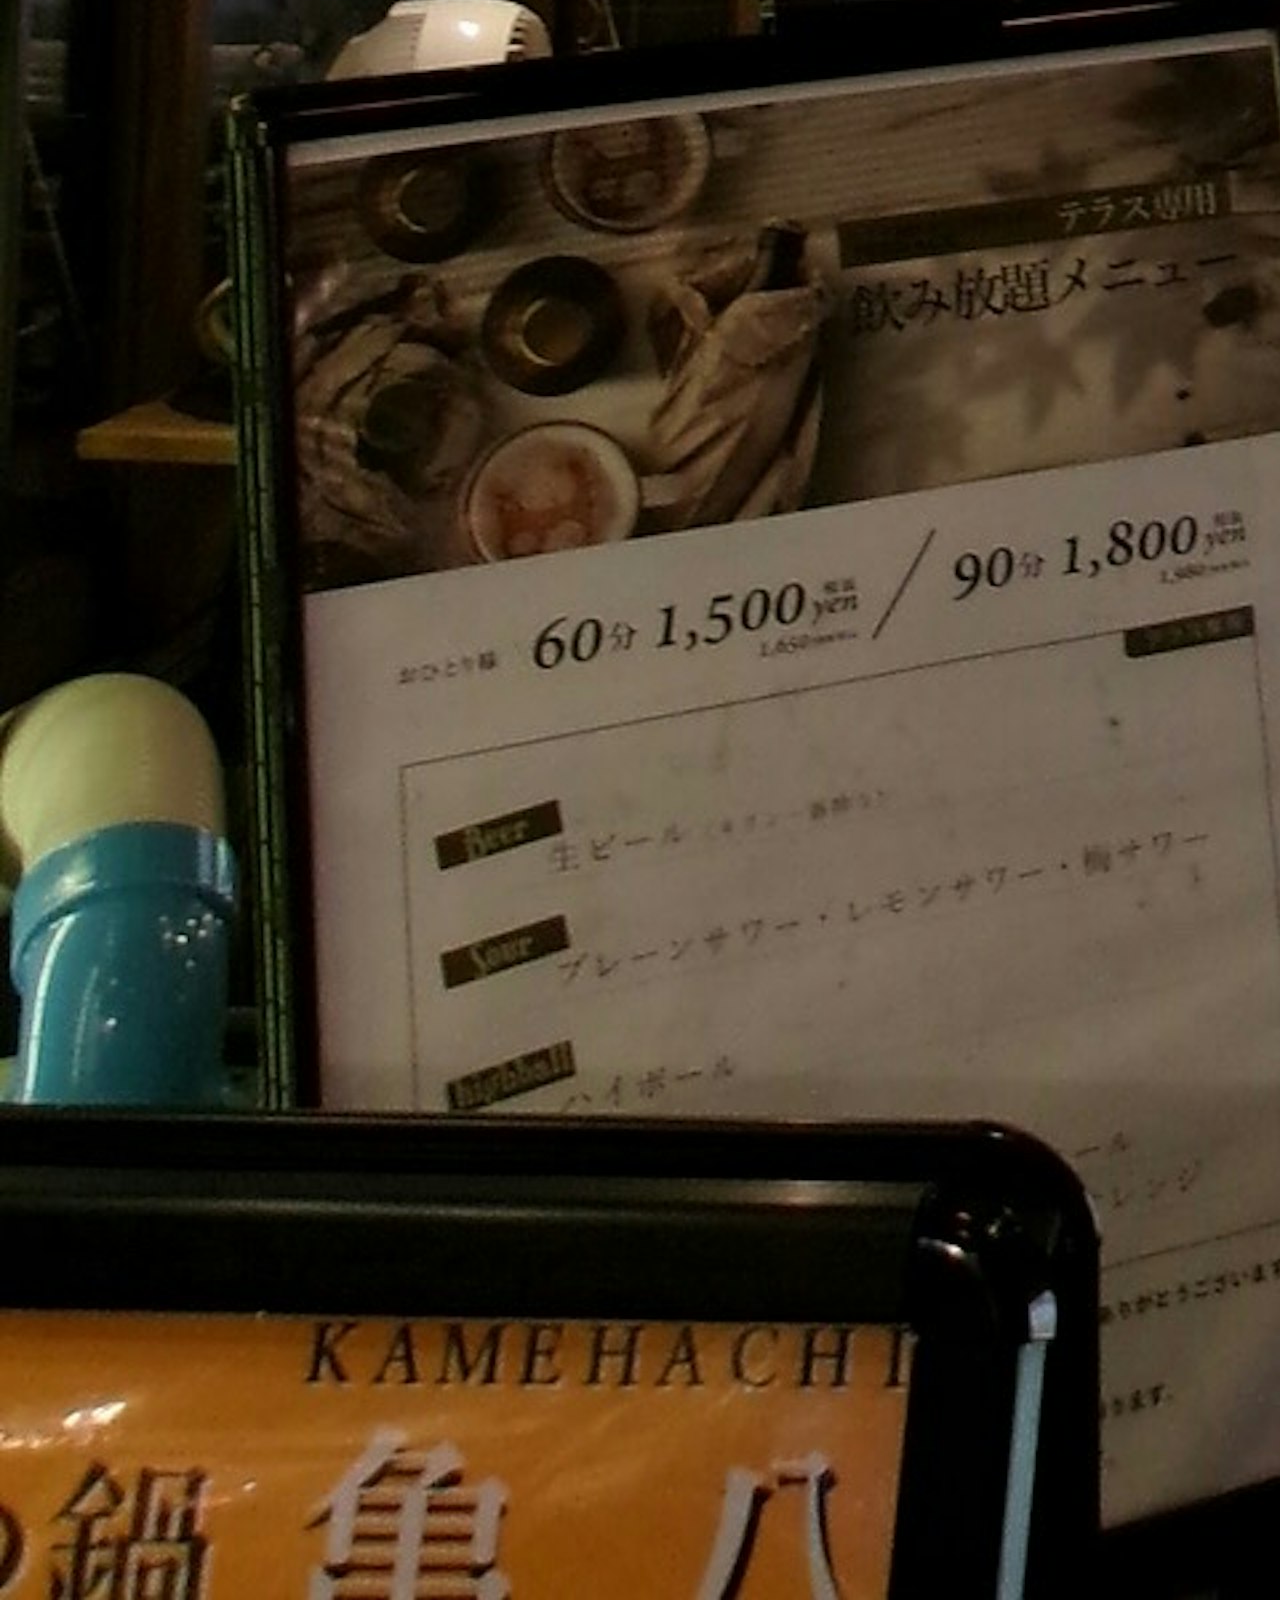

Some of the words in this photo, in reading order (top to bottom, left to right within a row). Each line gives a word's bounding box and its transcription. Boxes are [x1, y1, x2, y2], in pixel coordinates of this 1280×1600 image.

[1058, 182, 1217, 235] テラス専用
[851, 254, 1240, 336] 飲み放題メニュー
[304, 1321, 912, 1389] KAMEHACHI
